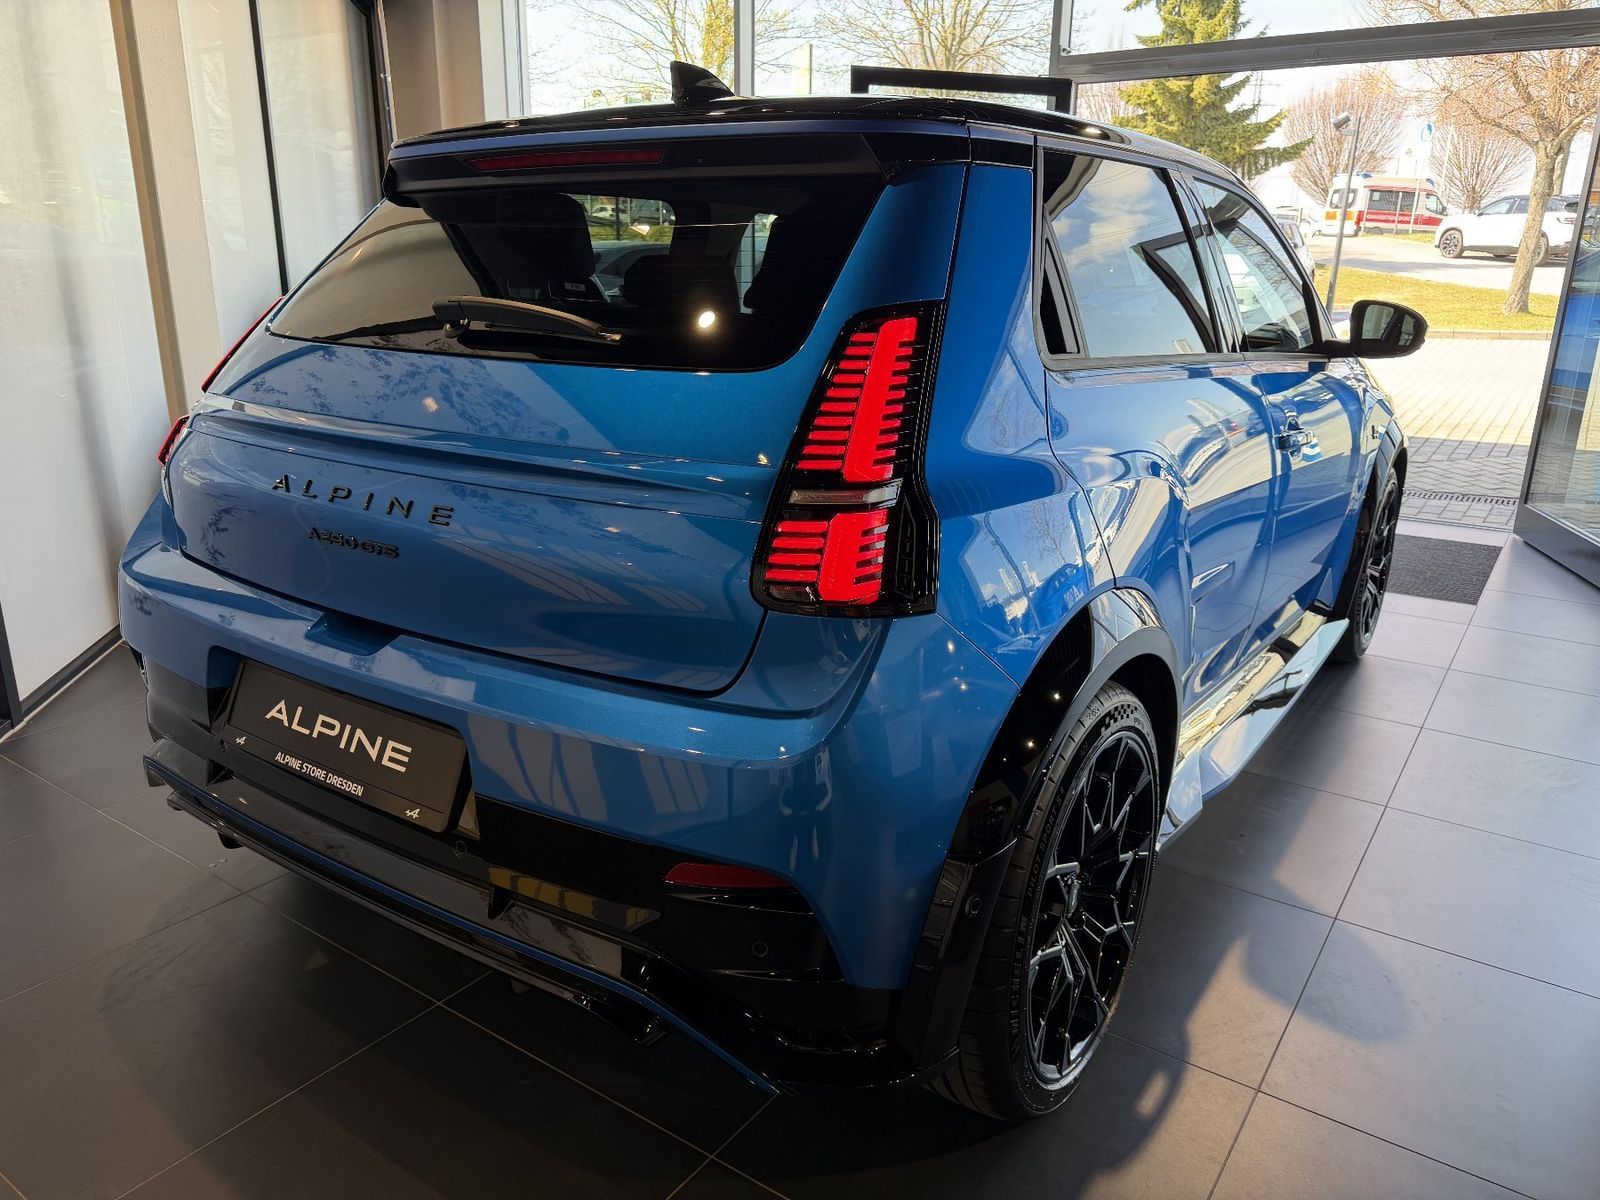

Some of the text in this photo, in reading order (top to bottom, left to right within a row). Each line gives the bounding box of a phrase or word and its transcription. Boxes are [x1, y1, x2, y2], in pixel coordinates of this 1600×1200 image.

[272, 474, 454, 527] ALPINE
[309, 527, 400, 560] A290 GTS
[265, 699, 413, 773] ALPINE
[275, 752, 364, 797] ALPINE STORE DRESDEN
[1027, 854, 1042, 897] PILOT
[1040, 806, 1058, 852] SPORT
[1009, 915, 1029, 1035] MICHELIN
